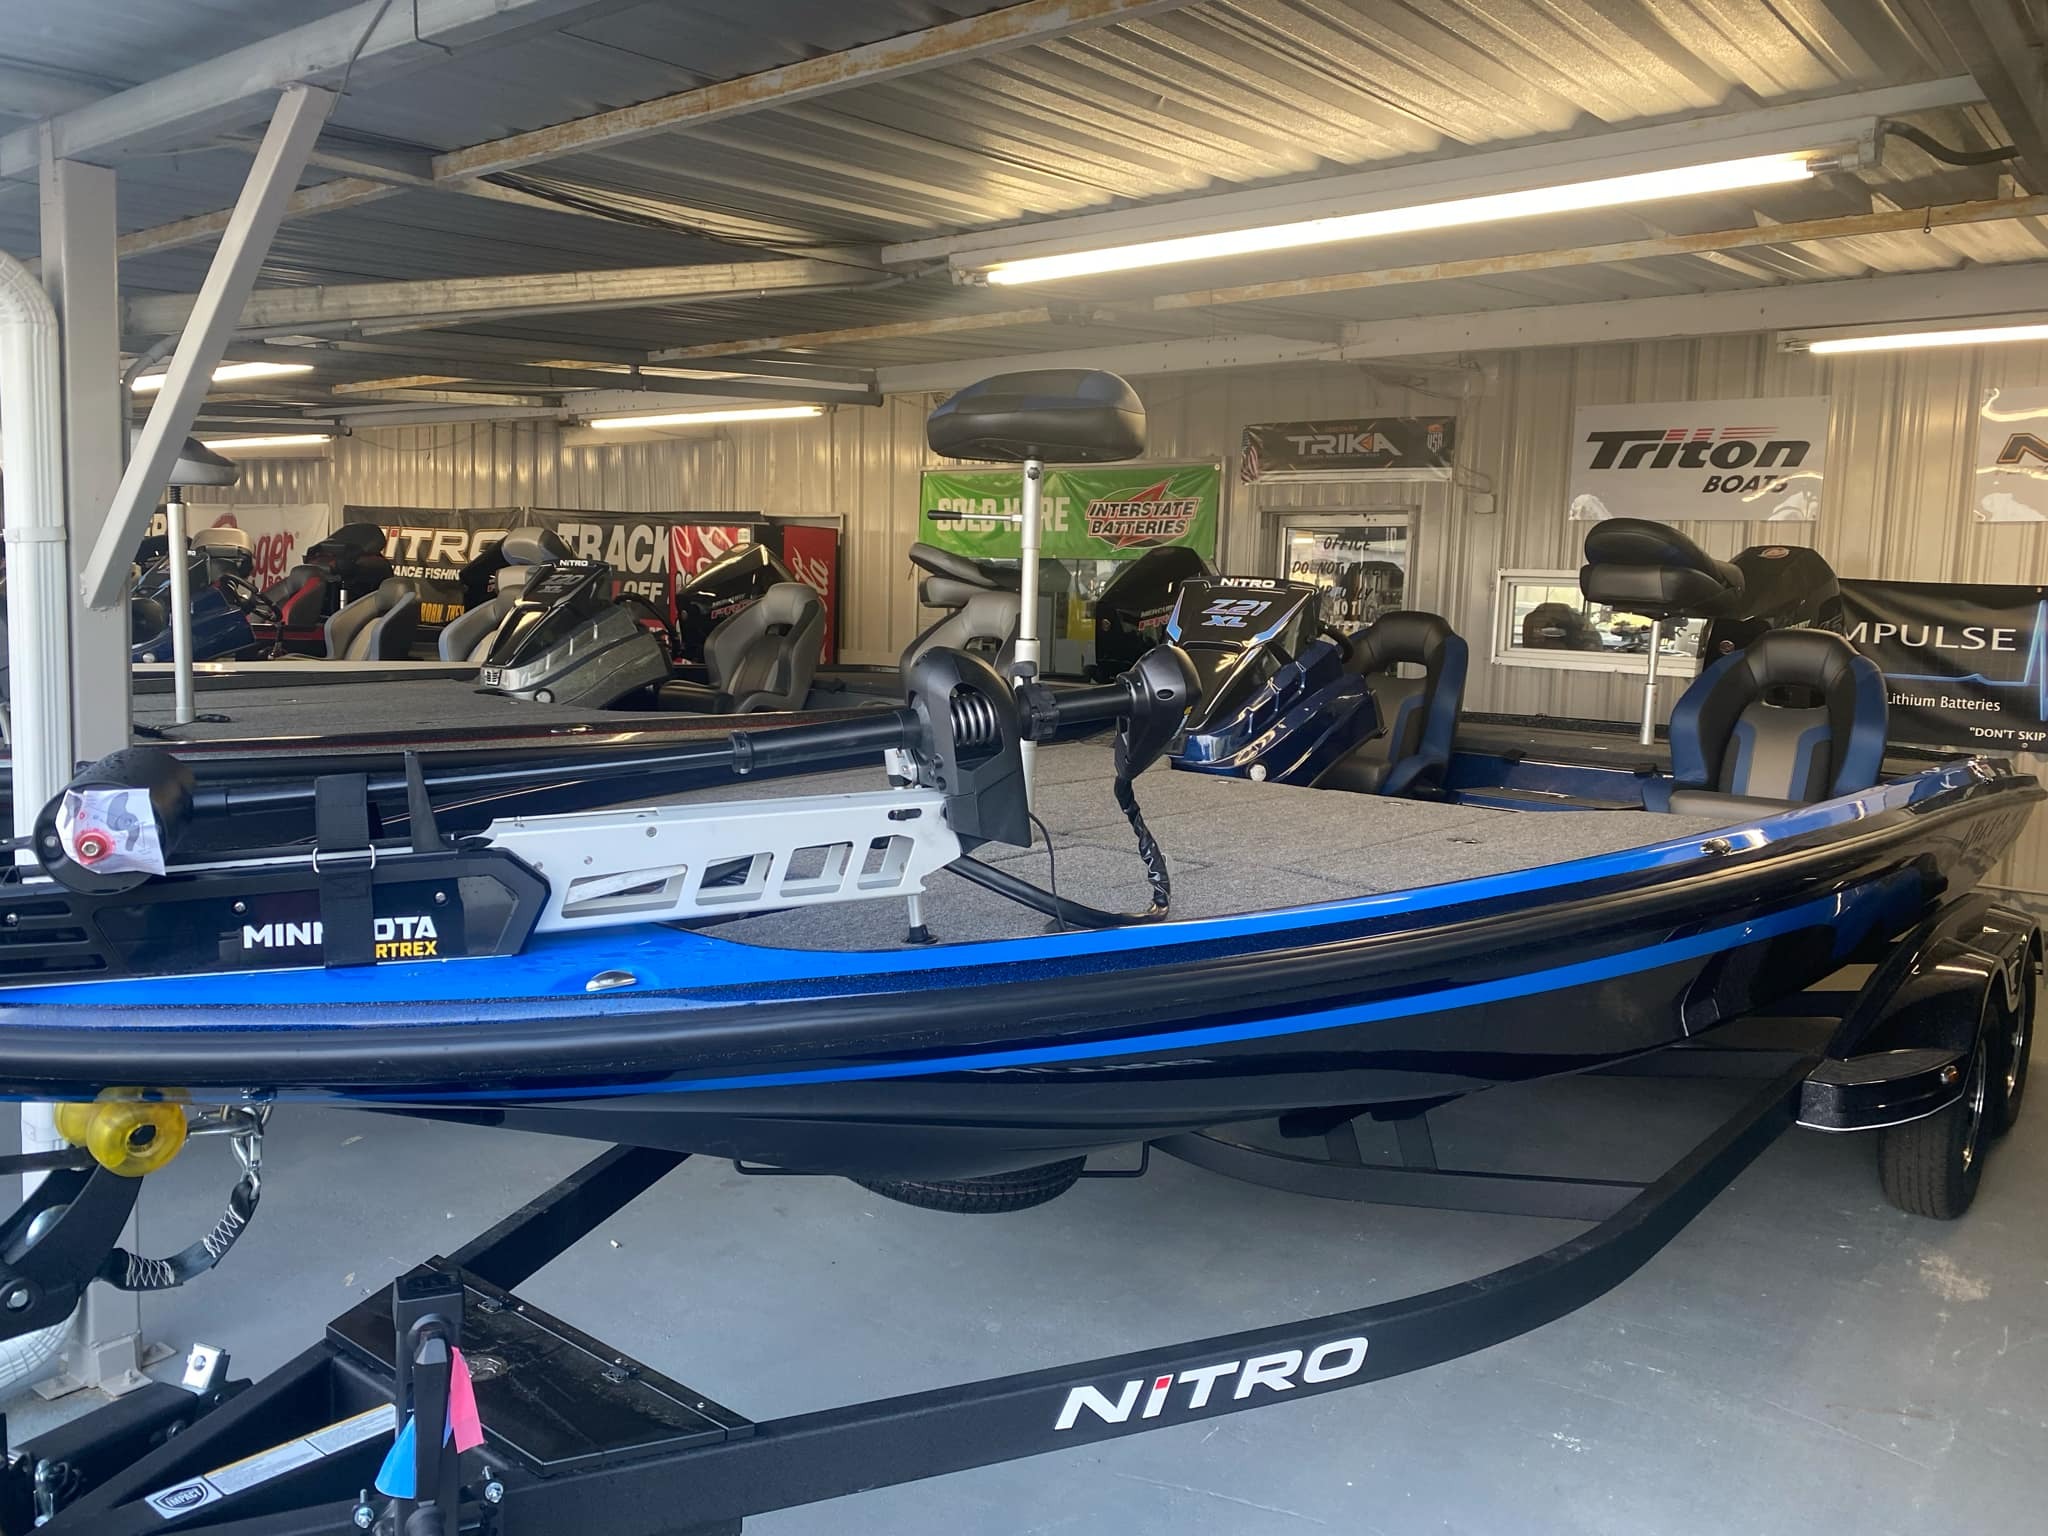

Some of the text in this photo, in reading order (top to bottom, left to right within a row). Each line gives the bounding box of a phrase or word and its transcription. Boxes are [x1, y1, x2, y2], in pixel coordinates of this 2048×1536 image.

[1286, 433, 1403, 456] TRIKA
[1587, 427, 1811, 470] Triton
[1702, 475, 1788, 493] BOATS
[937, 496, 1070, 532] SOLD HRE
[1088, 501, 1194, 517] INTERSTATE
[1091, 519, 1186, 535] BATTERIES
[558, 523, 669, 574] TRACK
[425, 567, 461, 581] FISHIN
[1292, 560, 1309, 575] DO
[1201, 599, 1272, 617] Z21
[1201, 615, 1248, 627] XL
[1845, 622, 2017, 651] MPULSE
[1887, 693, 2001, 712] Lithium Batteries
[2018, 731, 2047, 742] SKIP
[374, 916, 438, 941] OTA
